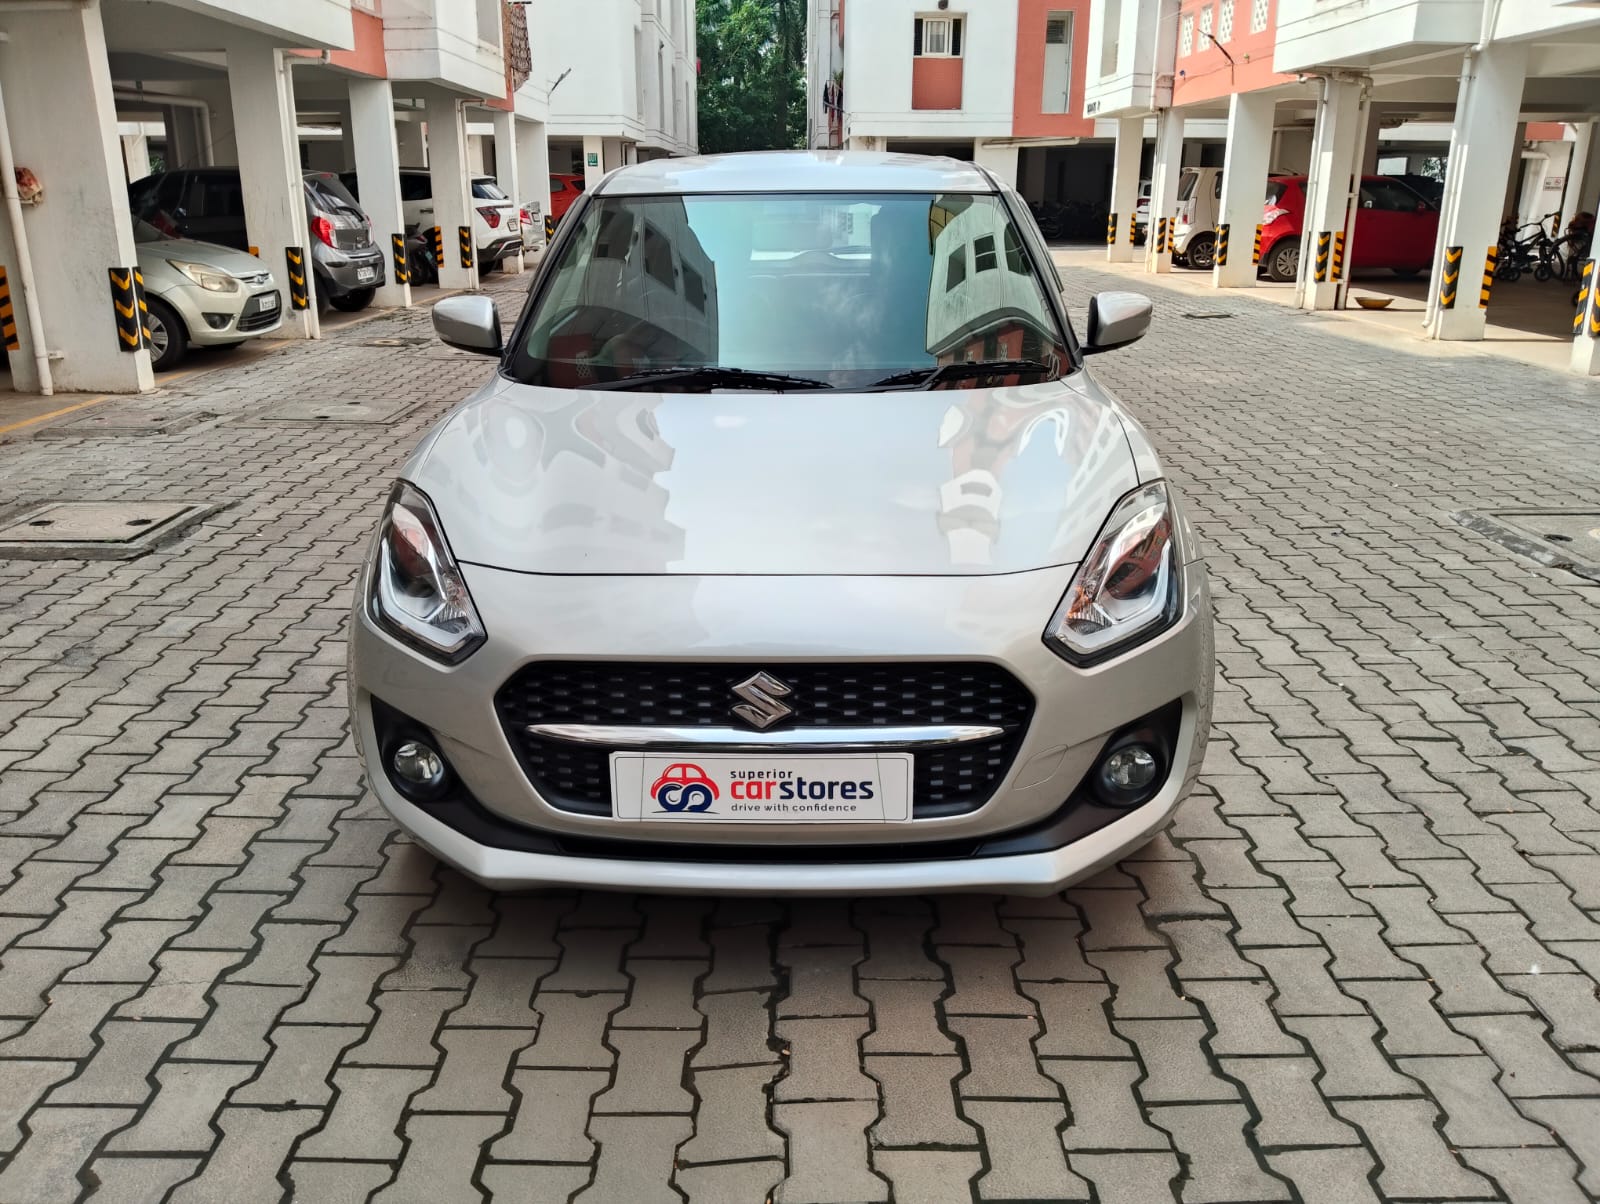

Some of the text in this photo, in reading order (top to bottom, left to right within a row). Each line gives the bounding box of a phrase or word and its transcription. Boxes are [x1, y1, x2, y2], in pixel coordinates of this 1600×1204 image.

[730, 768, 793, 780] superior
[730, 777, 874, 800] carstores
[731, 803, 857, 812] drive with confidence
